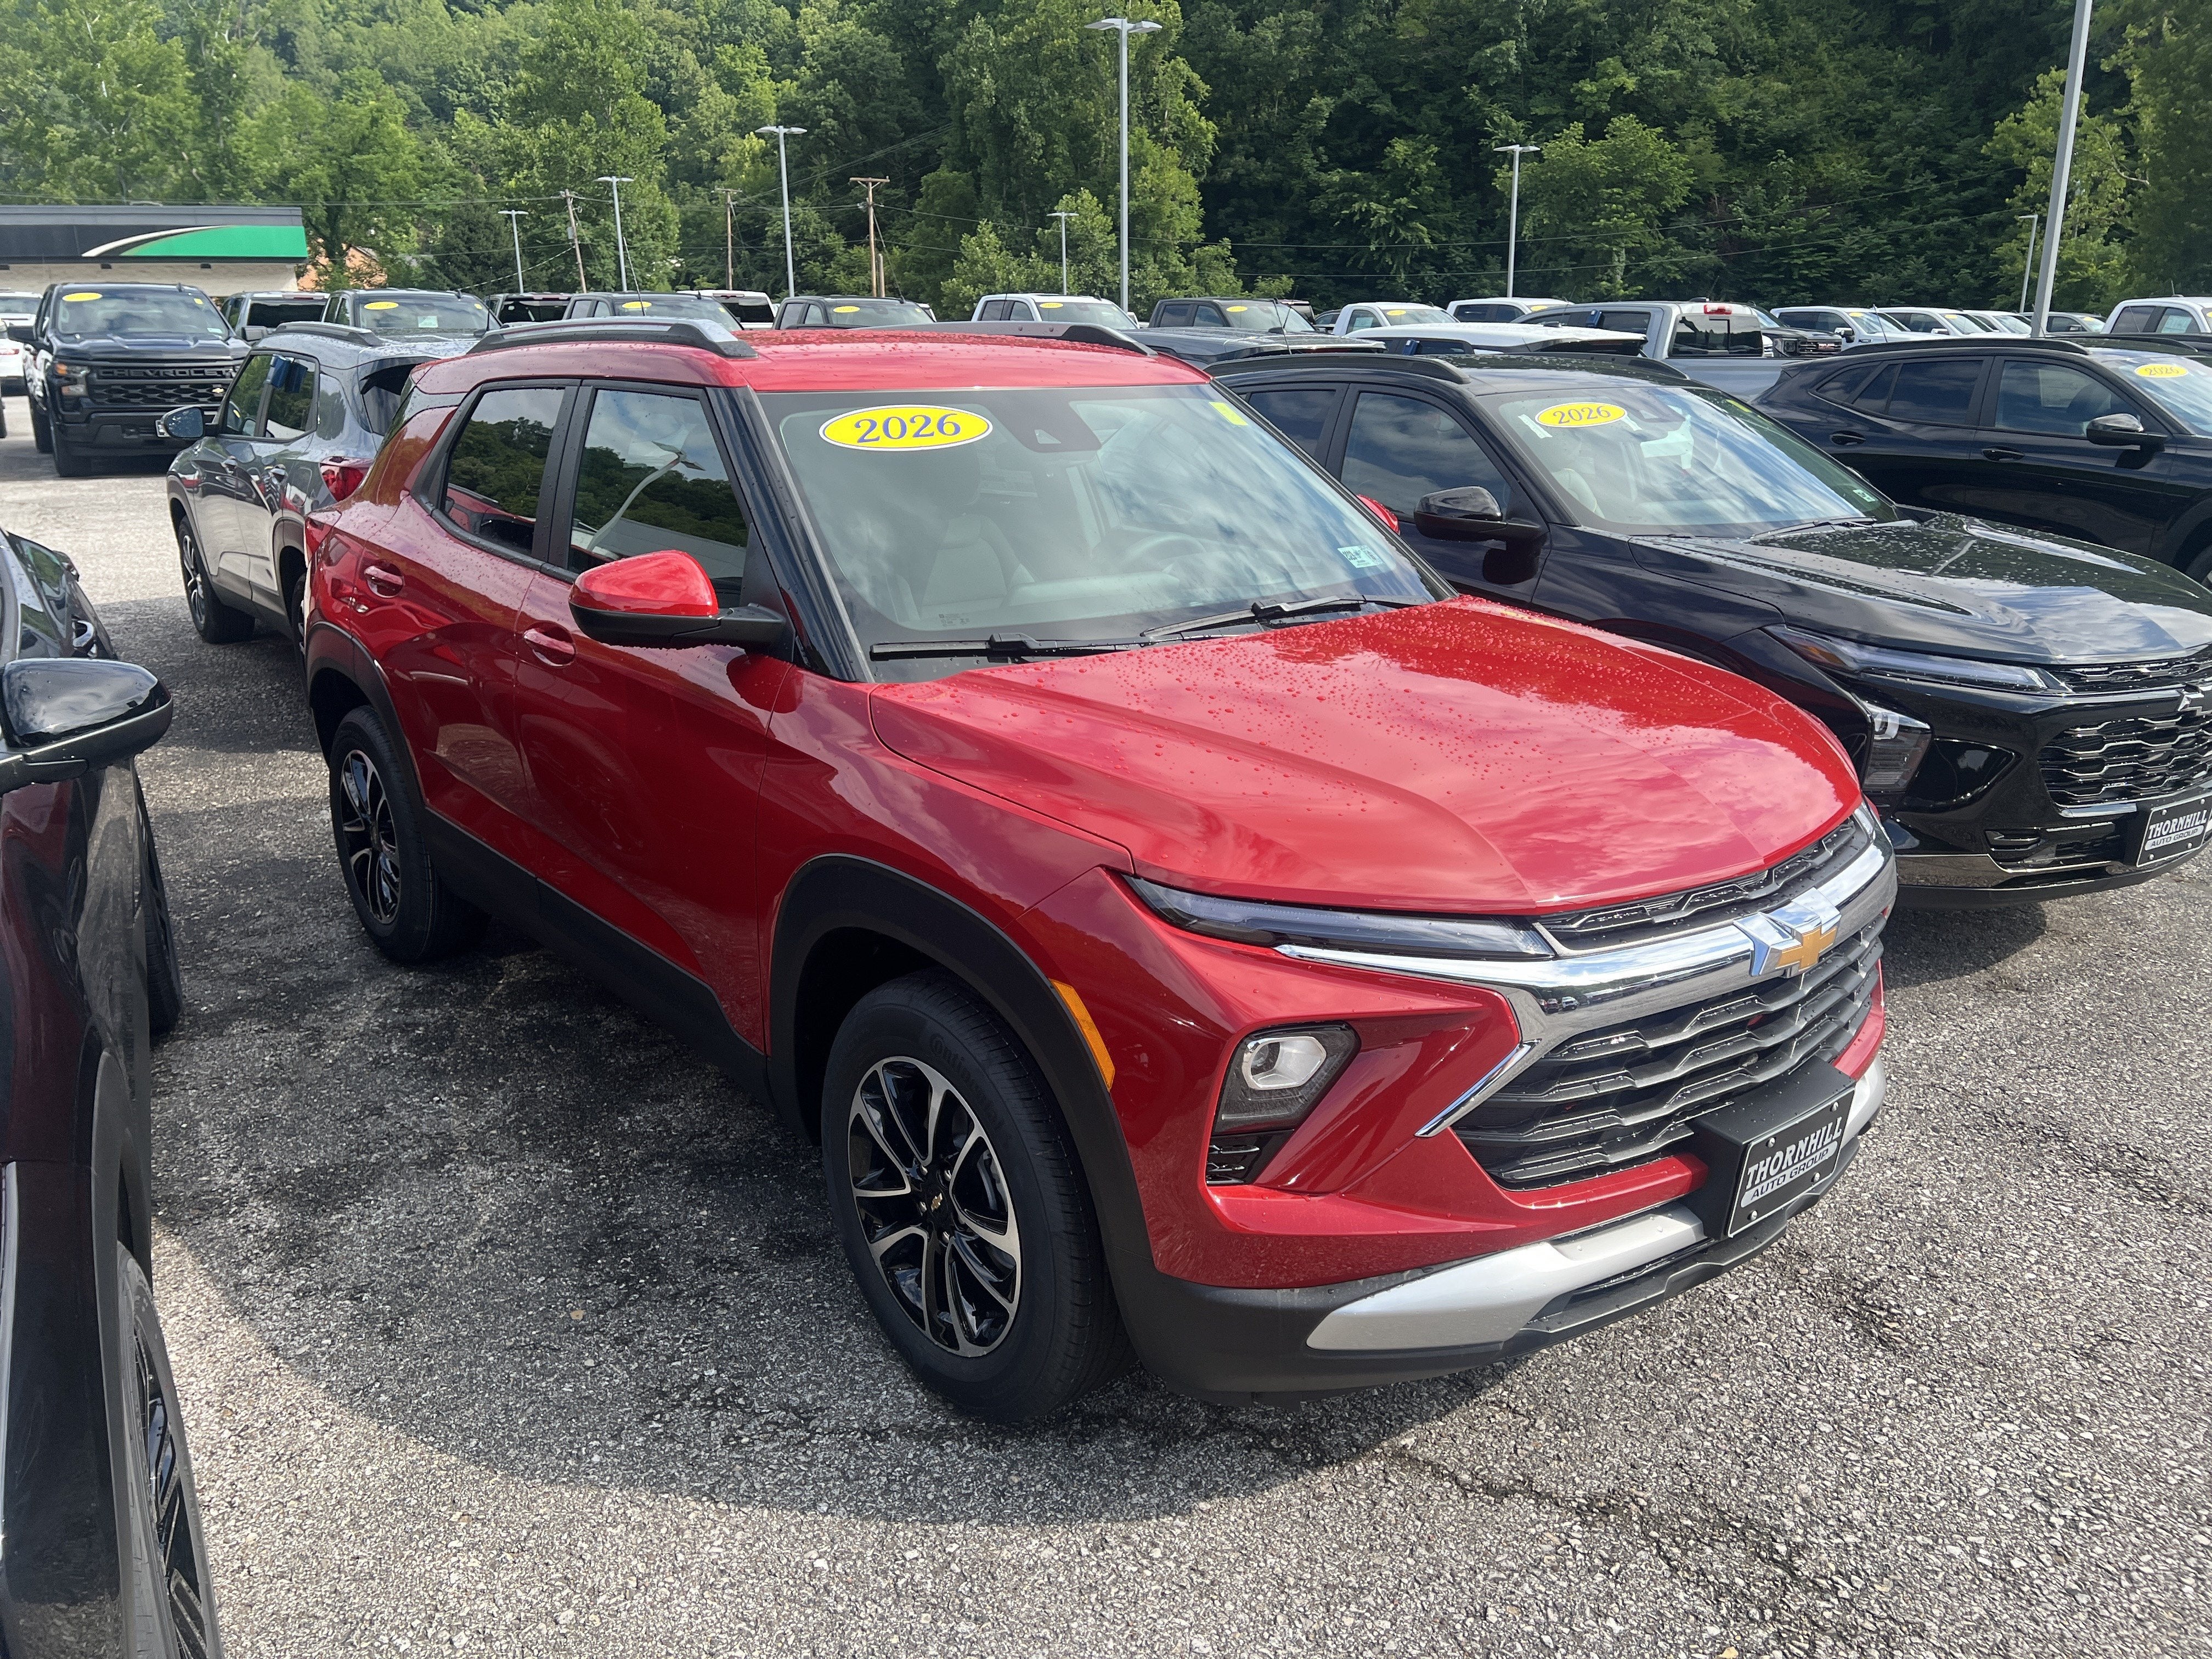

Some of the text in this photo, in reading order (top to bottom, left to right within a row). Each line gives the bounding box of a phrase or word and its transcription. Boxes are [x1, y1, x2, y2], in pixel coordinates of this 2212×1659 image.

[2145, 366, 2180, 376] 2026
[854, 413, 961, 443] 2026
[1553, 405, 1611, 424] 2026
[2148, 810, 2208, 839] THORNHILL
[2151, 828, 2198, 848] AUTO GROUP
[1746, 1116, 1843, 1190] THORNHILL
[1751, 1148, 1829, 1201] AUTO GROUP
